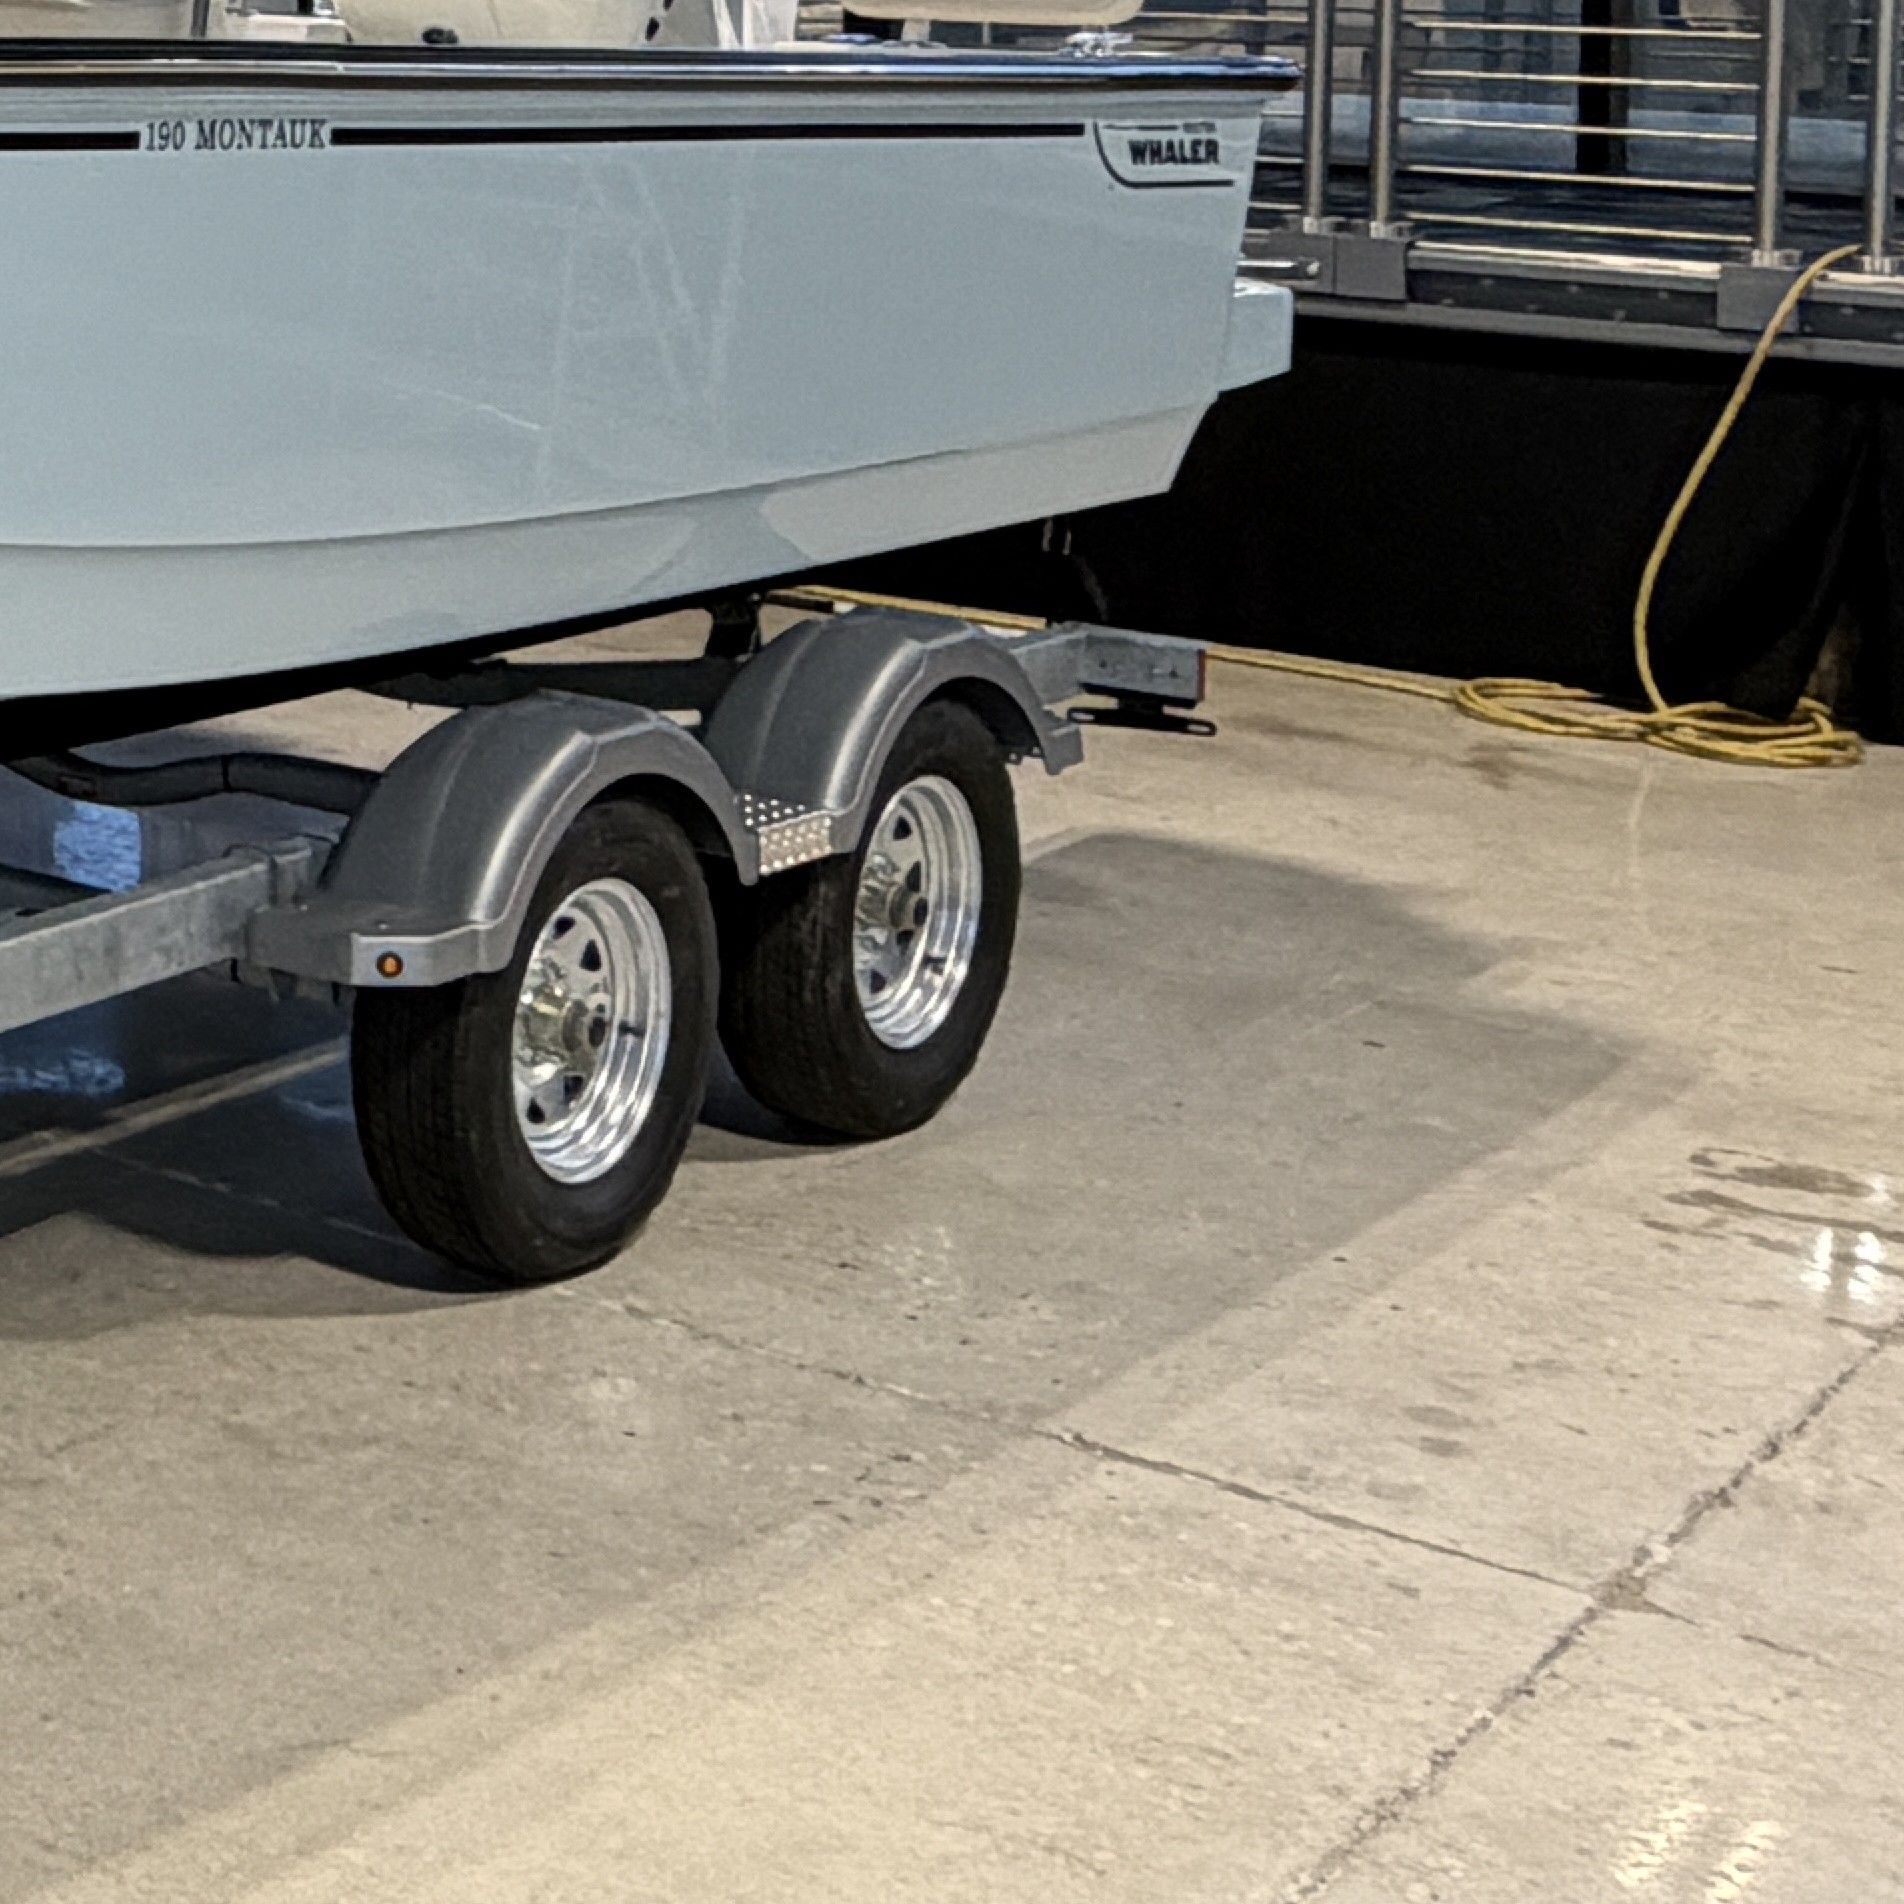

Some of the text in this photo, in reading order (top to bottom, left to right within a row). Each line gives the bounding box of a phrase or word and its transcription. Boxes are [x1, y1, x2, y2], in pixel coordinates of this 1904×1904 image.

[145, 118, 328, 151] 190 MONTAUK
[1128, 138, 1219, 165] WHALER
